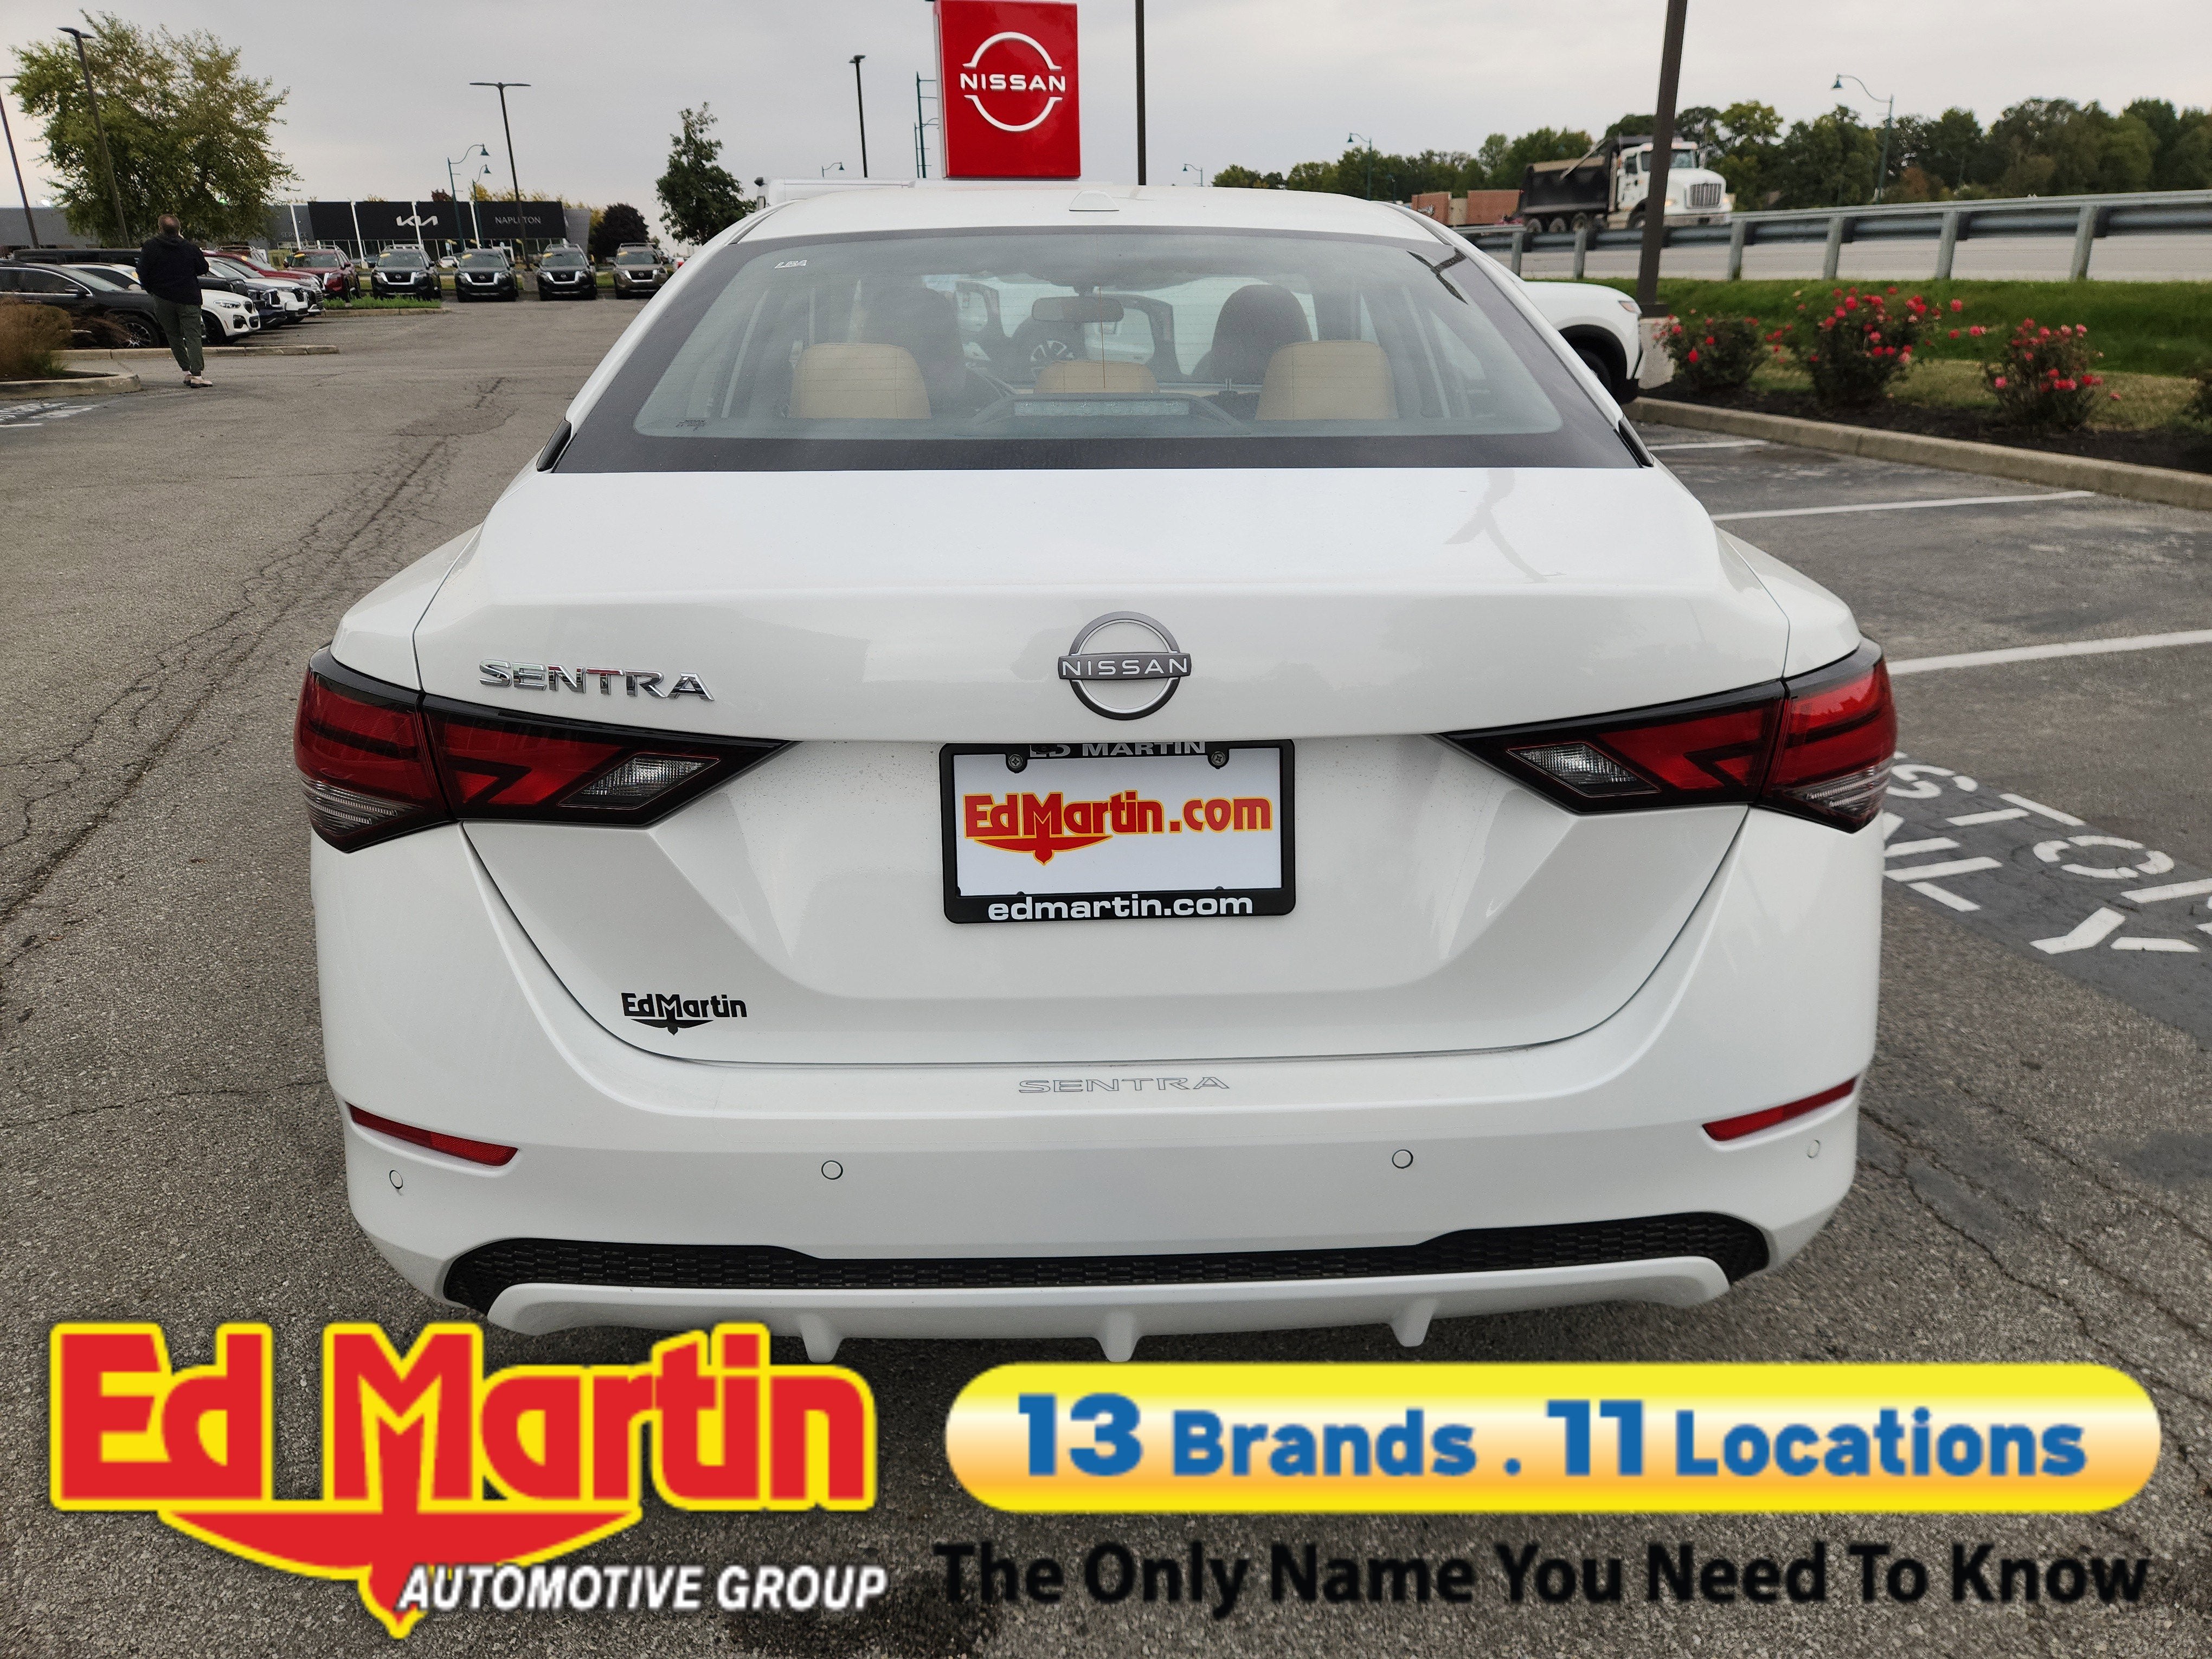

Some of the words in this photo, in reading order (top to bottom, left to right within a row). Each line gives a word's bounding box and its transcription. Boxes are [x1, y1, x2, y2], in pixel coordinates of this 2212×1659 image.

[960, 73, 1065, 92] NISSAN
[1063, 658, 1187, 675] NISSAN
[479, 659, 714, 700] SENTRA
[1083, 742, 1205, 756] MARTIN
[988, 894, 1253, 921] edmartin.com
[1019, 1076, 1230, 1093] SENTRA
